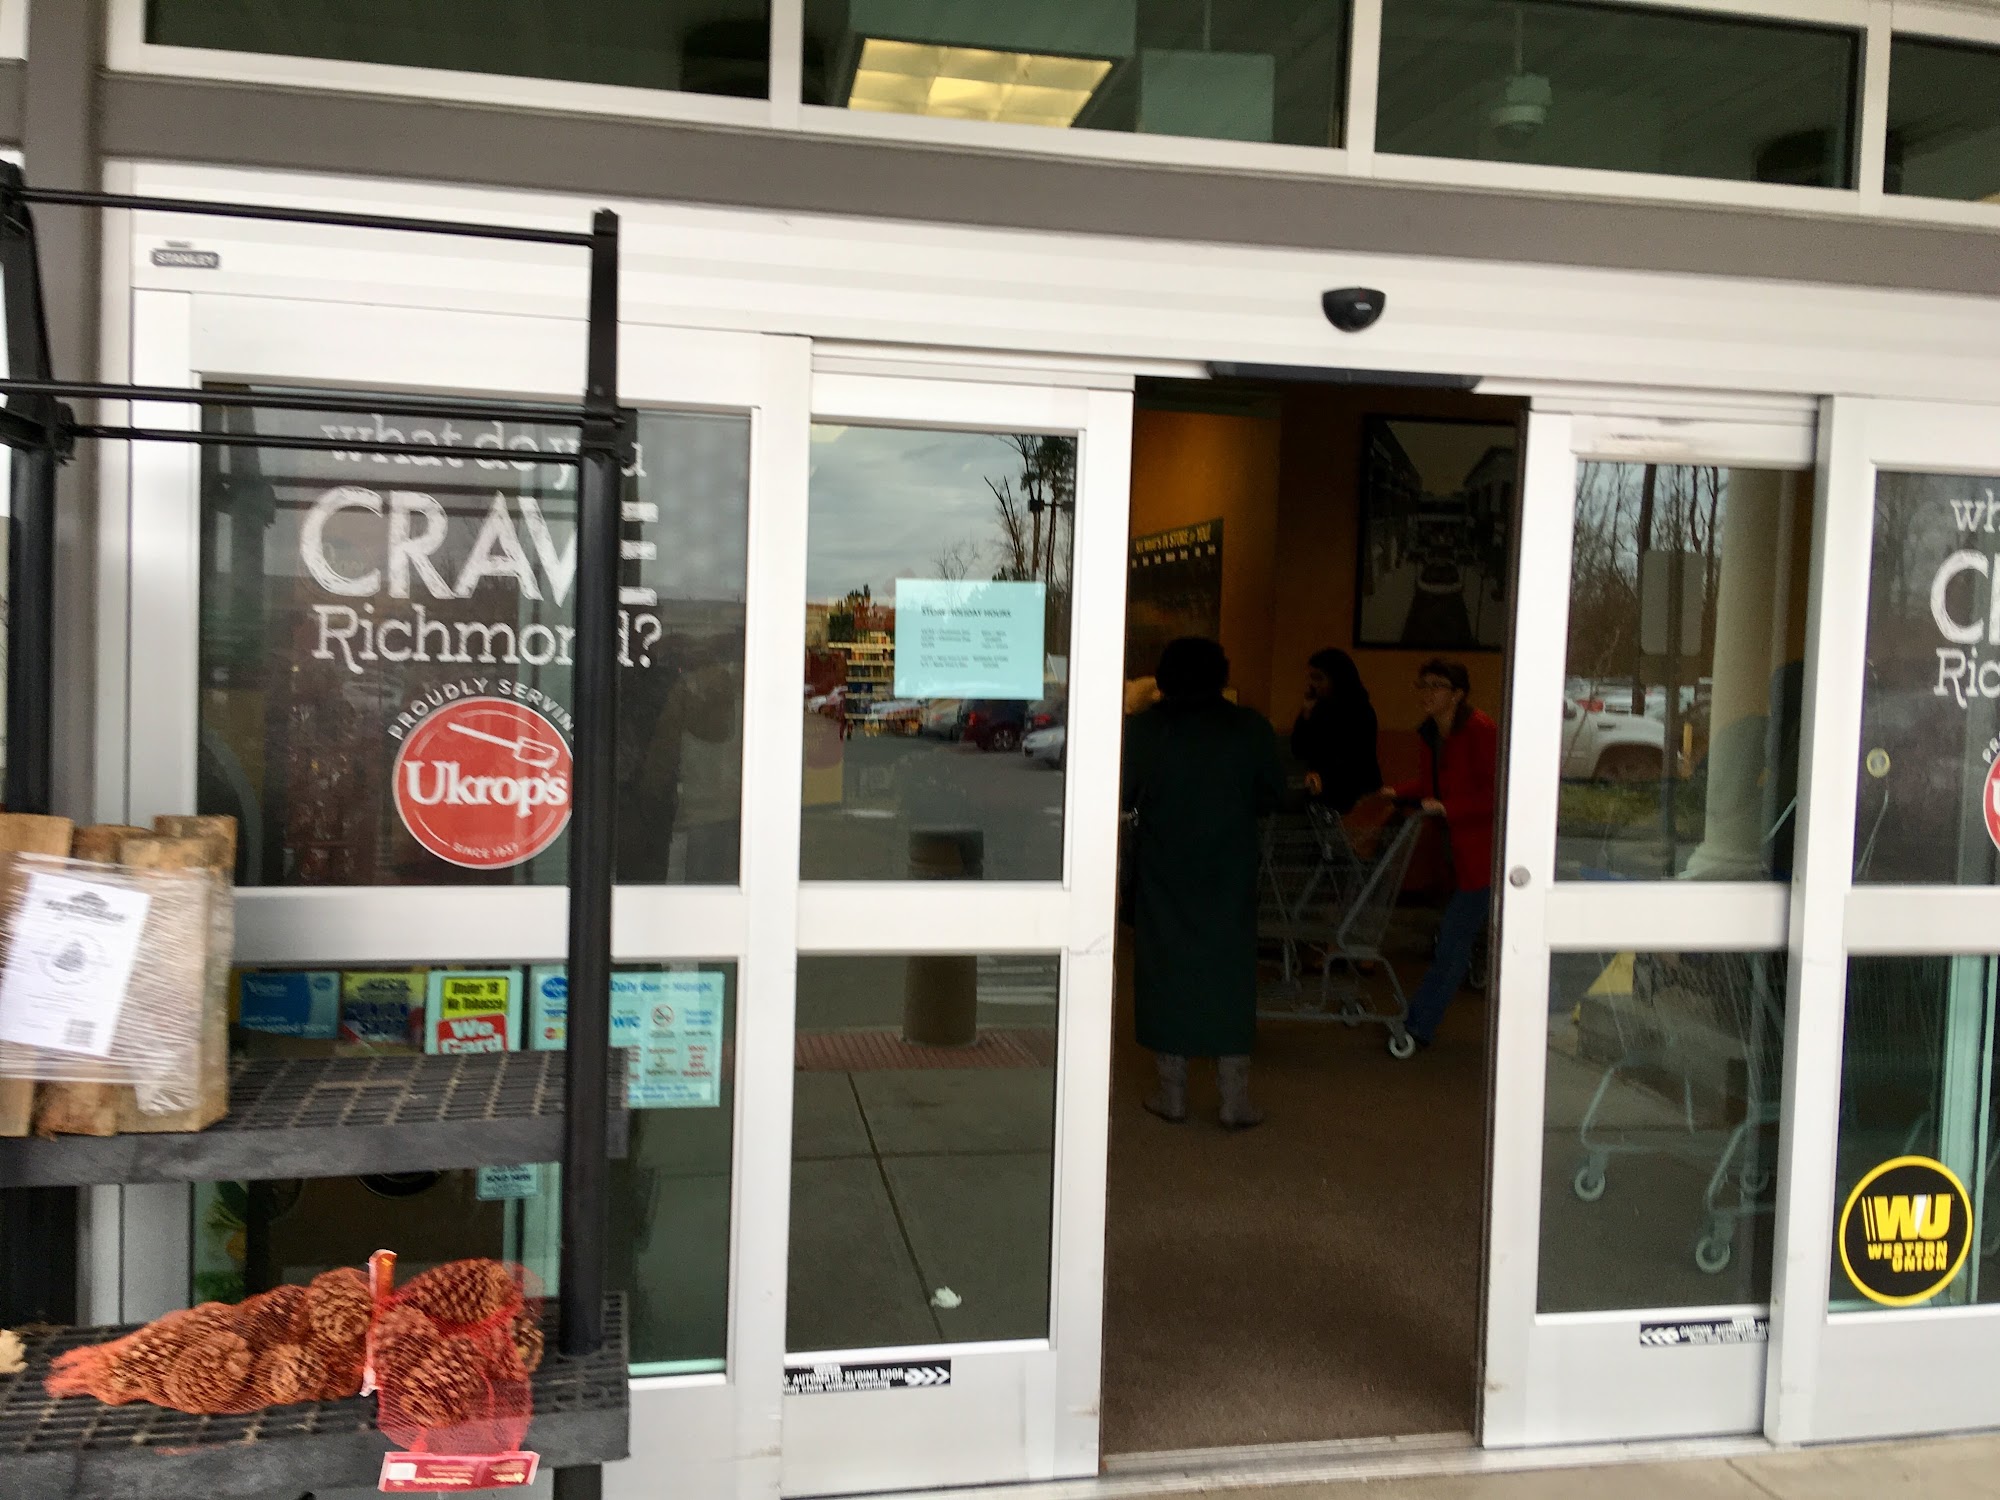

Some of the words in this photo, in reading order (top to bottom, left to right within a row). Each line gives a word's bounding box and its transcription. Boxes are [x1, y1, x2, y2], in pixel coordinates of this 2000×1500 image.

[320, 413, 465, 467] what
[473, 420, 540, 471] do
[547, 435, 648, 490] yu
[300, 485, 659, 607] CRAVE
[387, 676, 489, 741] PROUDLY
[497, 678, 575, 742] SERVIN
[404, 760, 569, 819] Ukrop's
[452, 841, 491, 859] SINCE
[452, 982, 483, 995] Under
[462, 996, 505, 1010] Tobacco
[449, 1019, 495, 1039] We
[440, 1033, 503, 1054] Card
[1862, 1193, 1952, 1242] WU
[1868, 1240, 1948, 1260] WESTERN
[1892, 1255, 1948, 1273] UNION
[844, 1368, 880, 1382] SLIDING
[880, 1367, 904, 1380] DOOR
